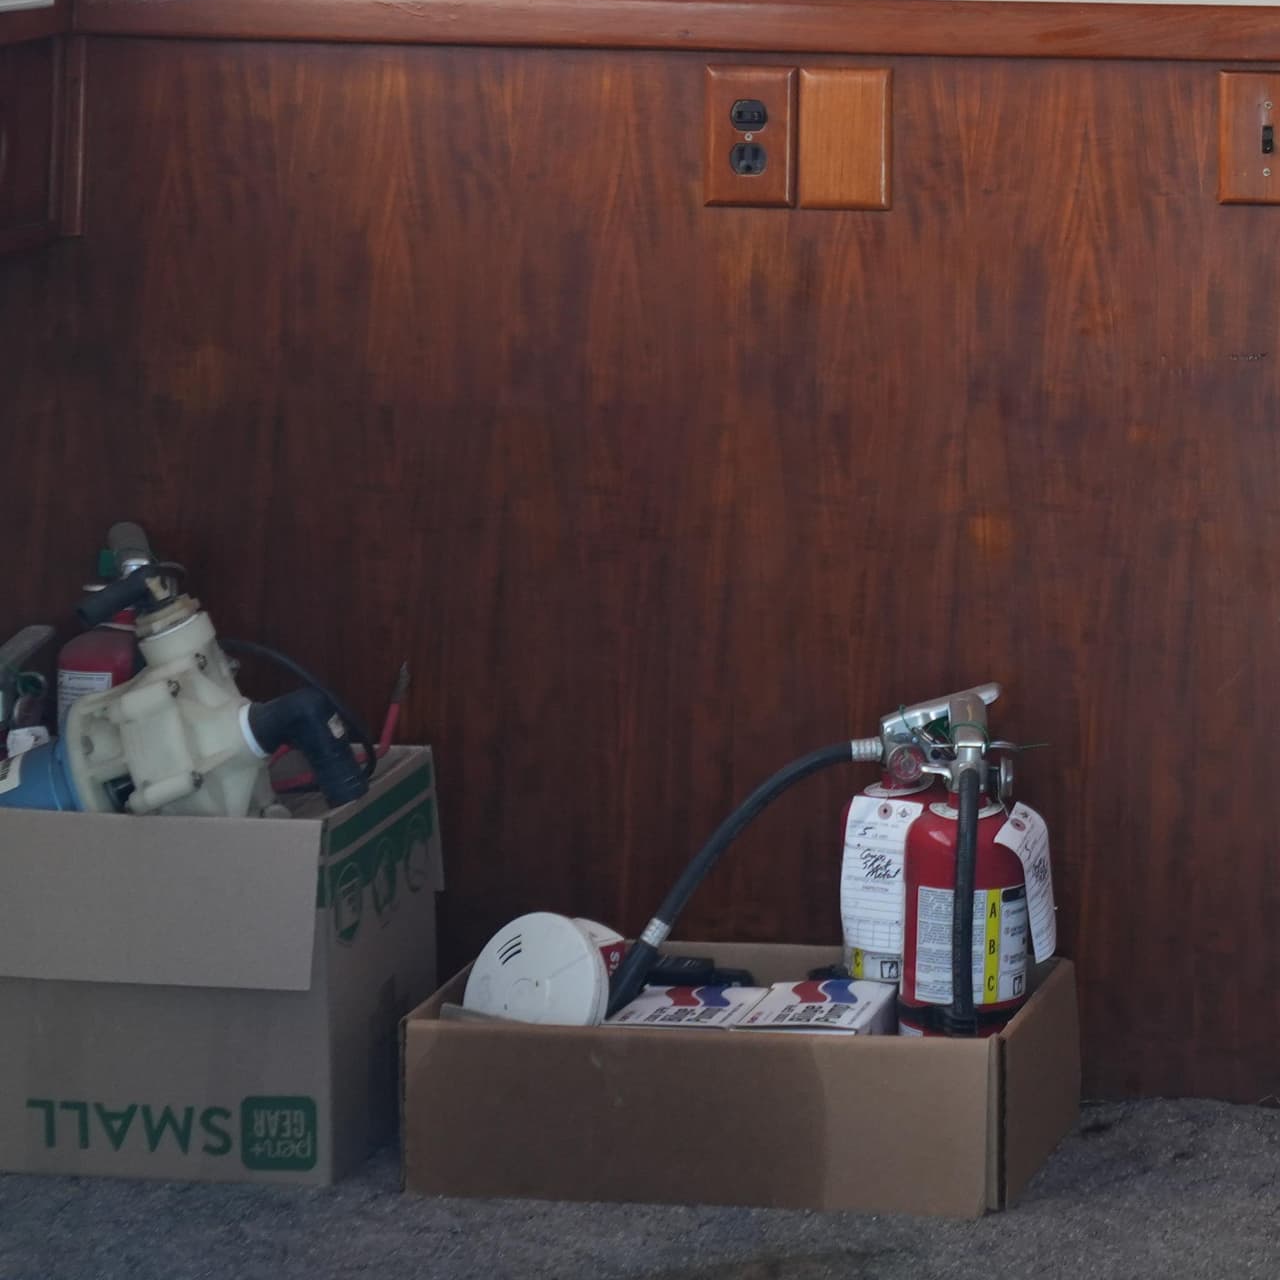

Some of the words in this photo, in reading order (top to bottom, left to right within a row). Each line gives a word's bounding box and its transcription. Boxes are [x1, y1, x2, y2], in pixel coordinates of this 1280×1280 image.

[989, 902, 998, 918] A
[988, 939, 996, 955] B
[987, 976, 995, 991] C
[26, 1098, 233, 1157] SMALL
[253, 1108, 306, 1138] GEAR
